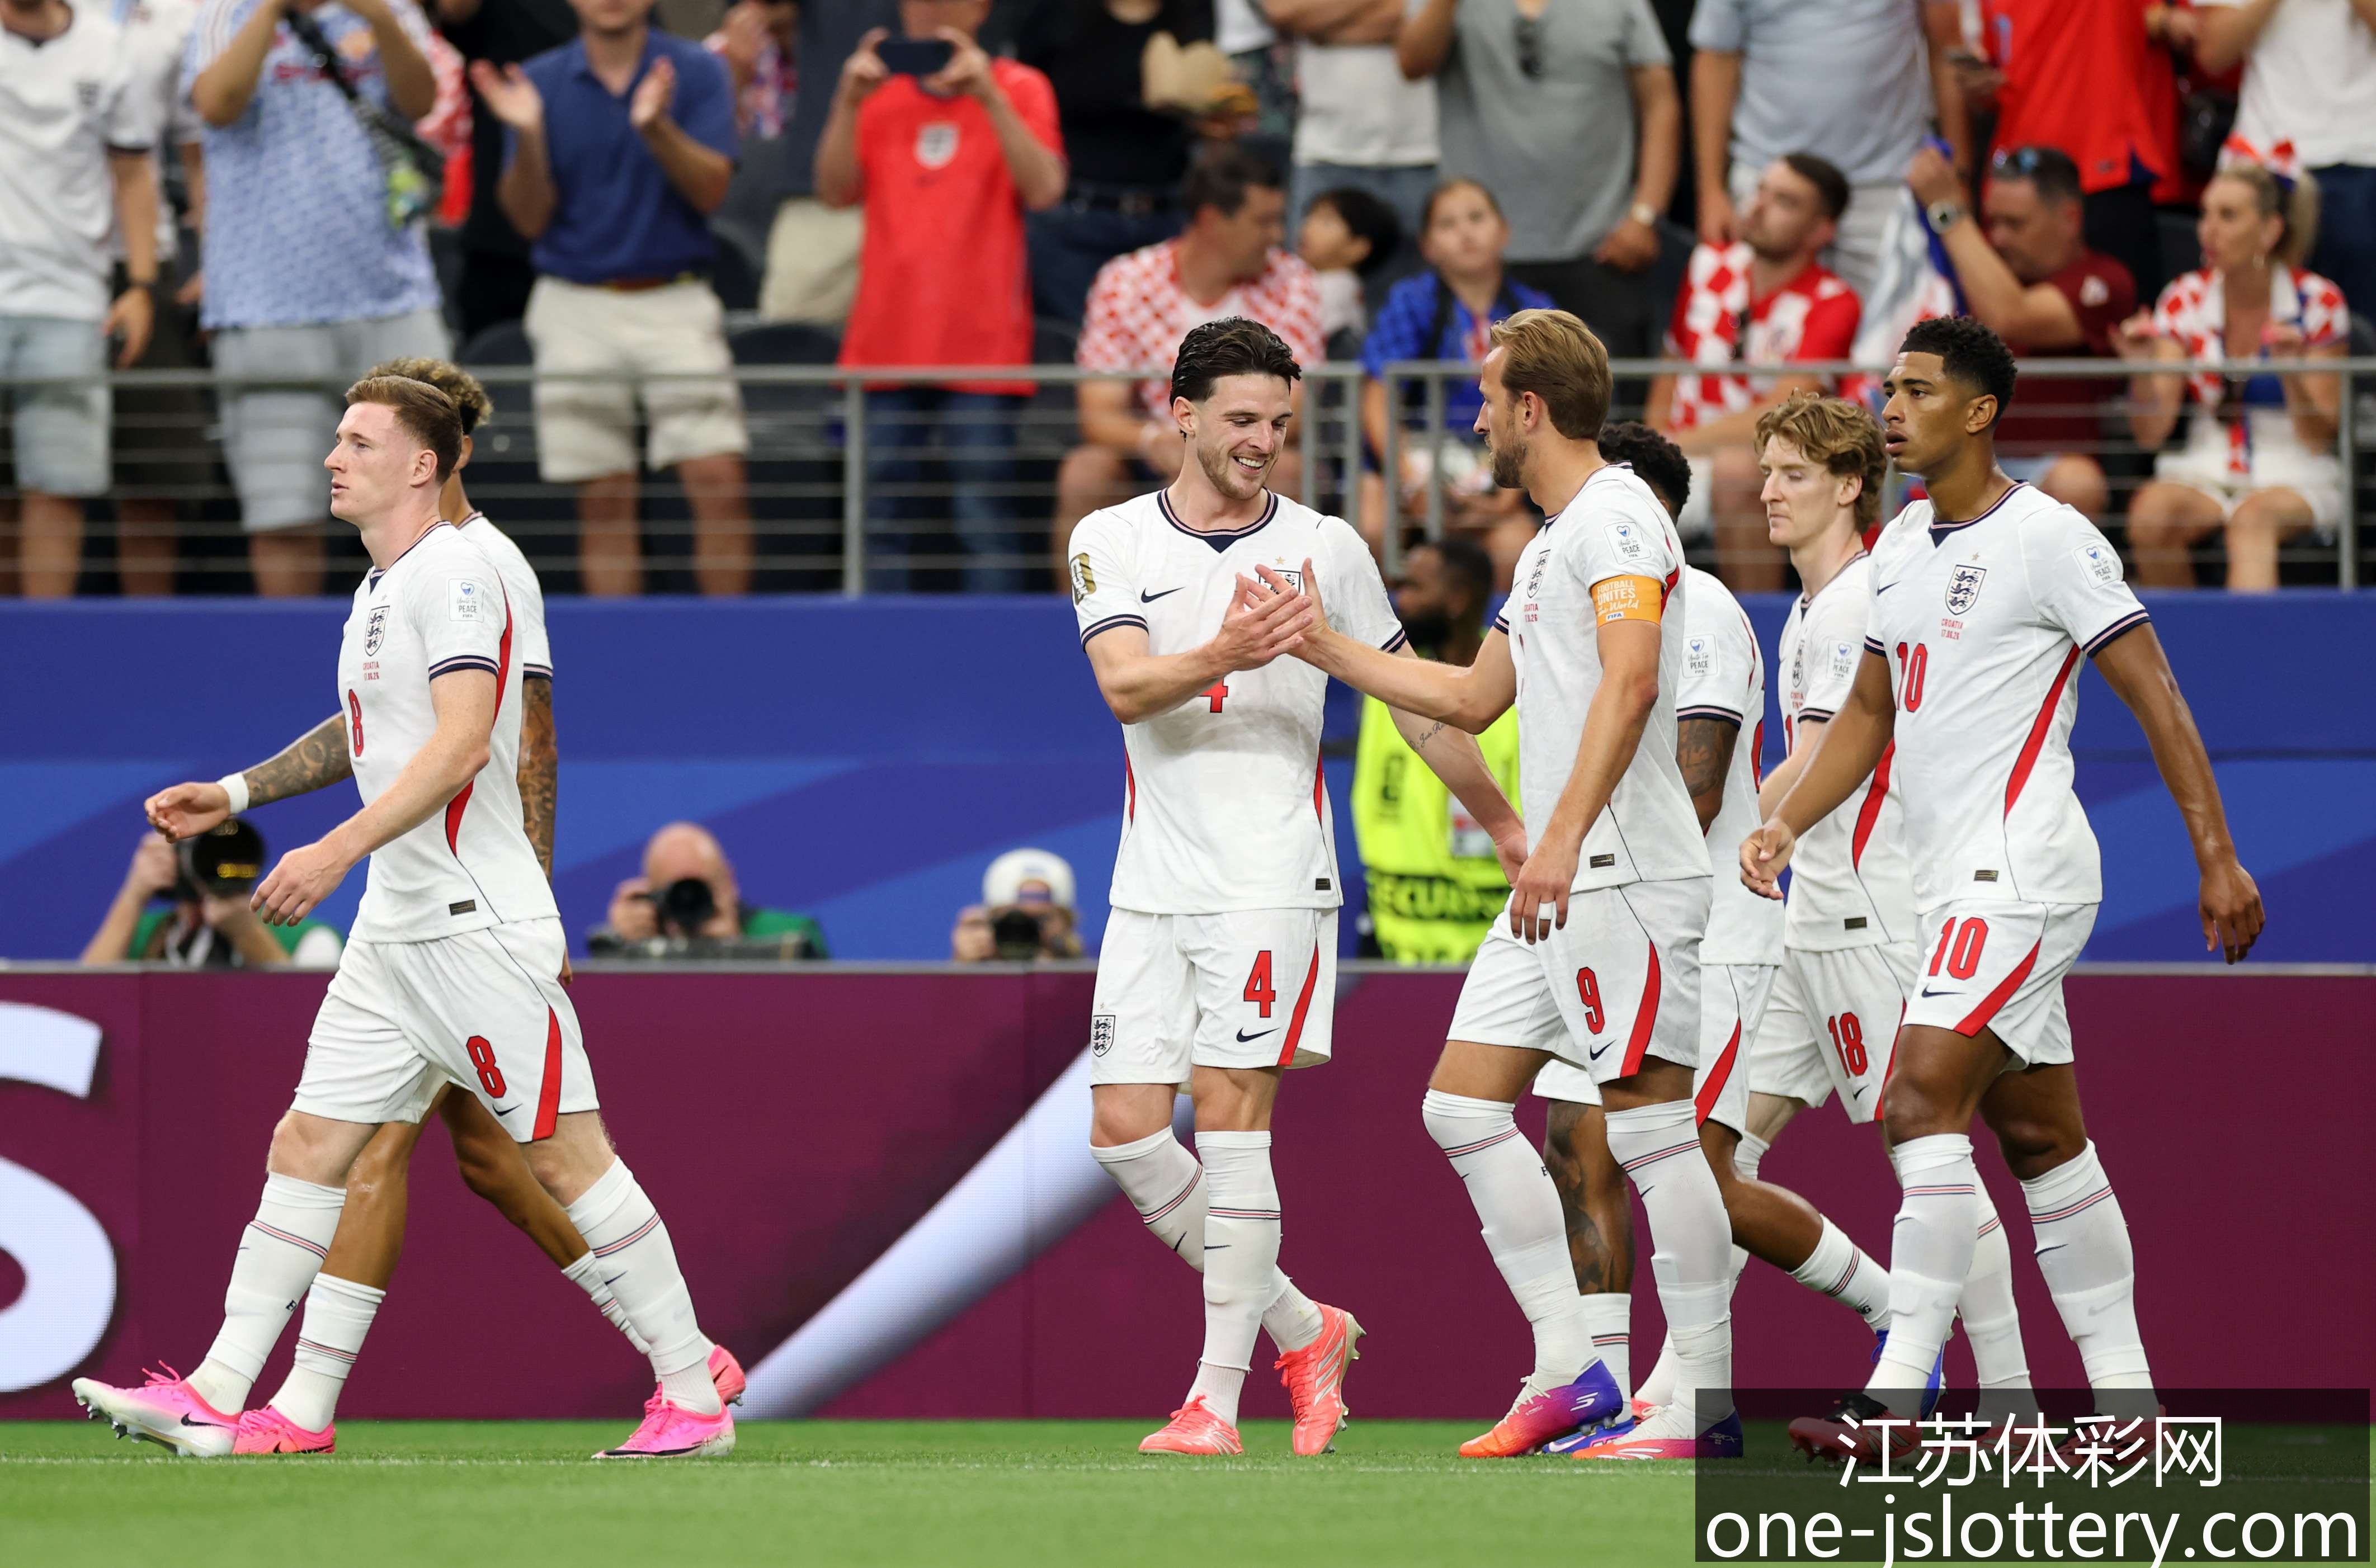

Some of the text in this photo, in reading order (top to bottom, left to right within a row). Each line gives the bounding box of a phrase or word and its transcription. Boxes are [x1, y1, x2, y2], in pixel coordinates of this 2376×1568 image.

[1622, 544, 1640, 554] PEACE
[2095, 566, 2112, 578] PEACE
[1597, 579, 1636, 593] FOOTBALL
[1597, 587, 1637, 606] UNITES
[1609, 598, 1640, 612] World
[459, 605, 477, 613] PEACE
[1941, 618, 1964, 629] CROATIA
[1690, 660, 1709, 669] PEACE
[1896, 641, 1929, 713] 10
[348, 689, 364, 757] 8
[1927, 916, 1989, 981] 10
[1243, 950, 1276, 1018] 4
[1576, 966, 1605, 1035] 9
[1827, 1012, 1868, 1079] 18
[466, 1035, 507, 1098] 8
